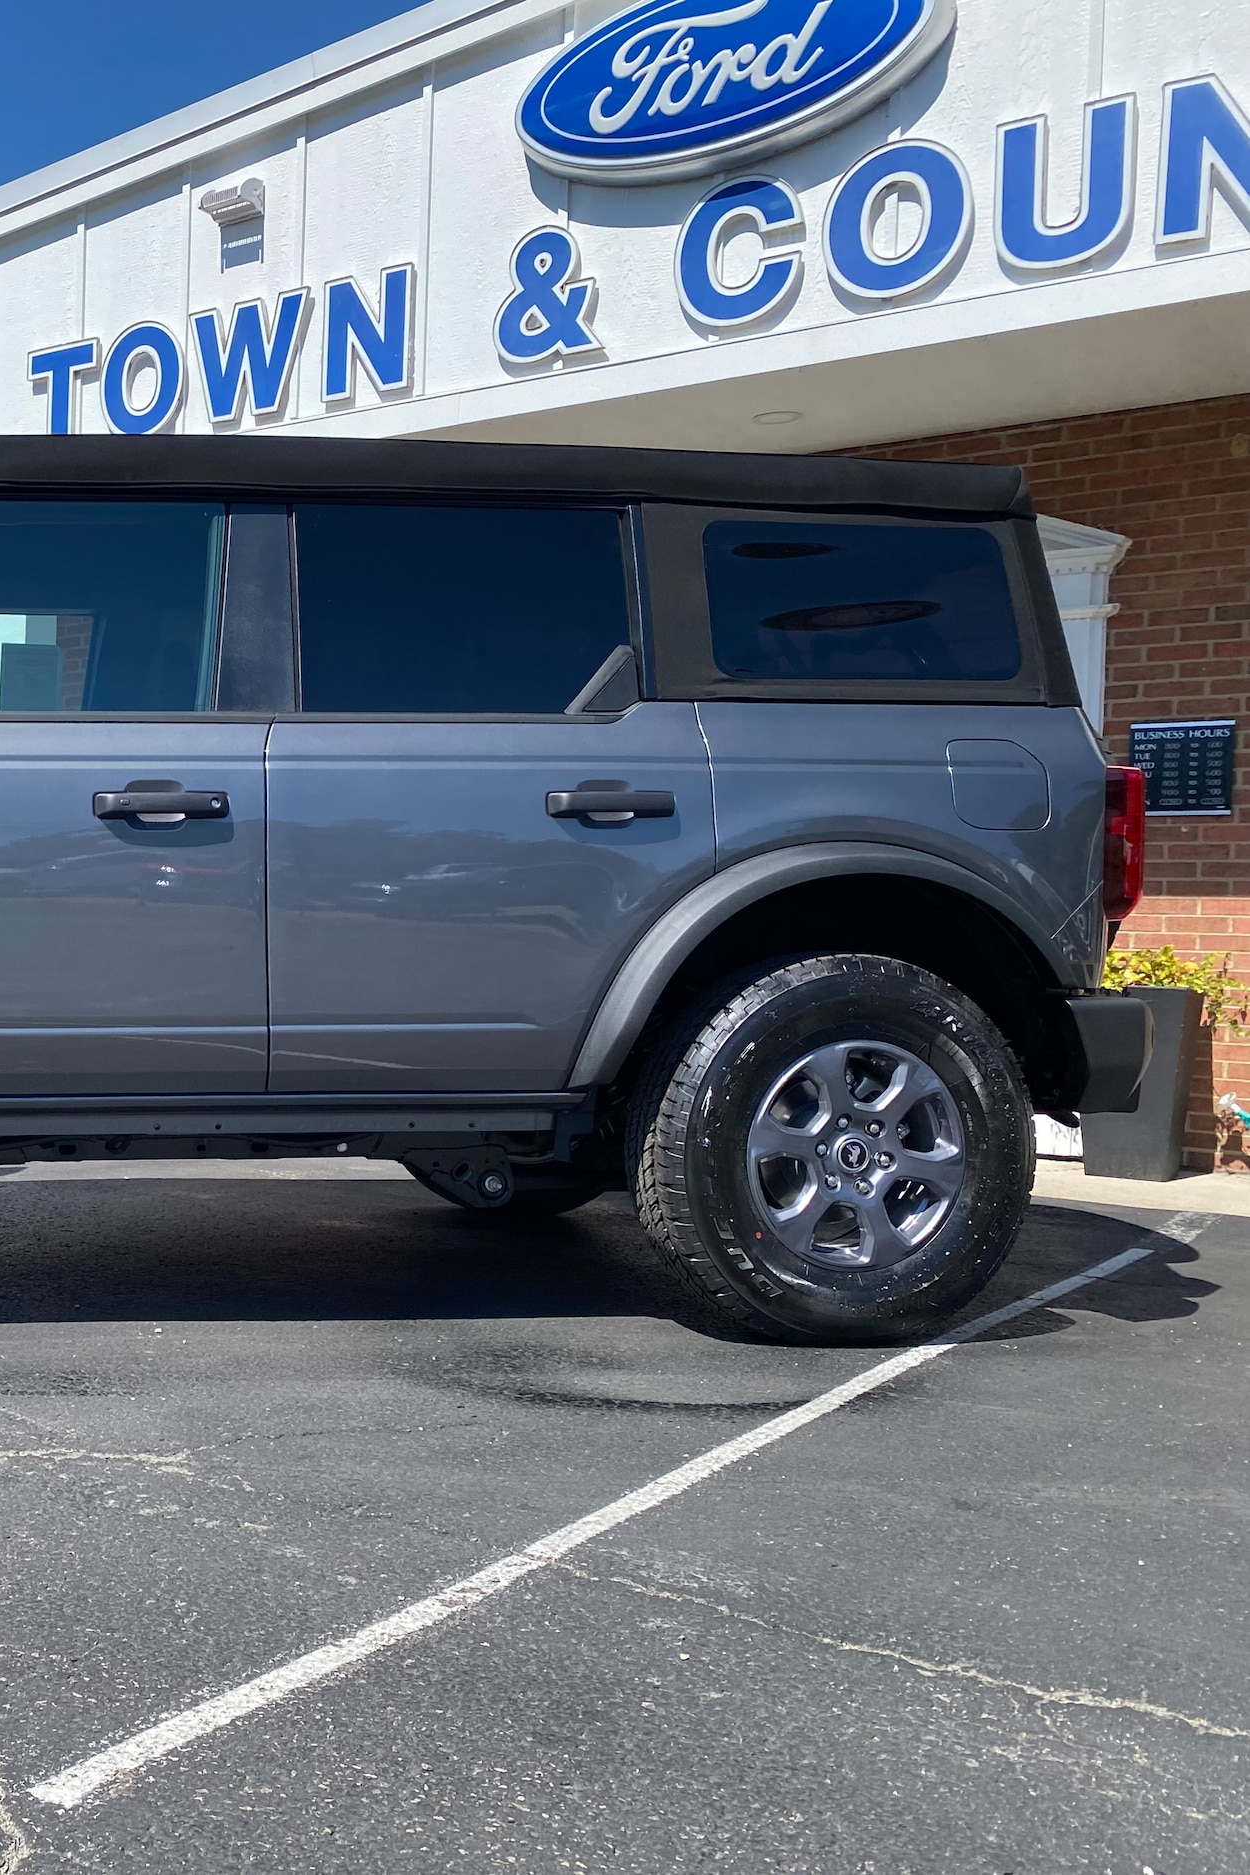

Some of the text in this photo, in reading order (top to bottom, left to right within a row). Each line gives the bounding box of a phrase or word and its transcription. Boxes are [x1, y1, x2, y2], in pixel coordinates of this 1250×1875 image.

[588, 0, 828, 134] Ford
[27, 262, 415, 434] TOWN
[493, 224, 603, 364] &
[1134, 728, 1230, 740] BUSINESS HOURS
[1134, 752, 1150, 760] TUE
